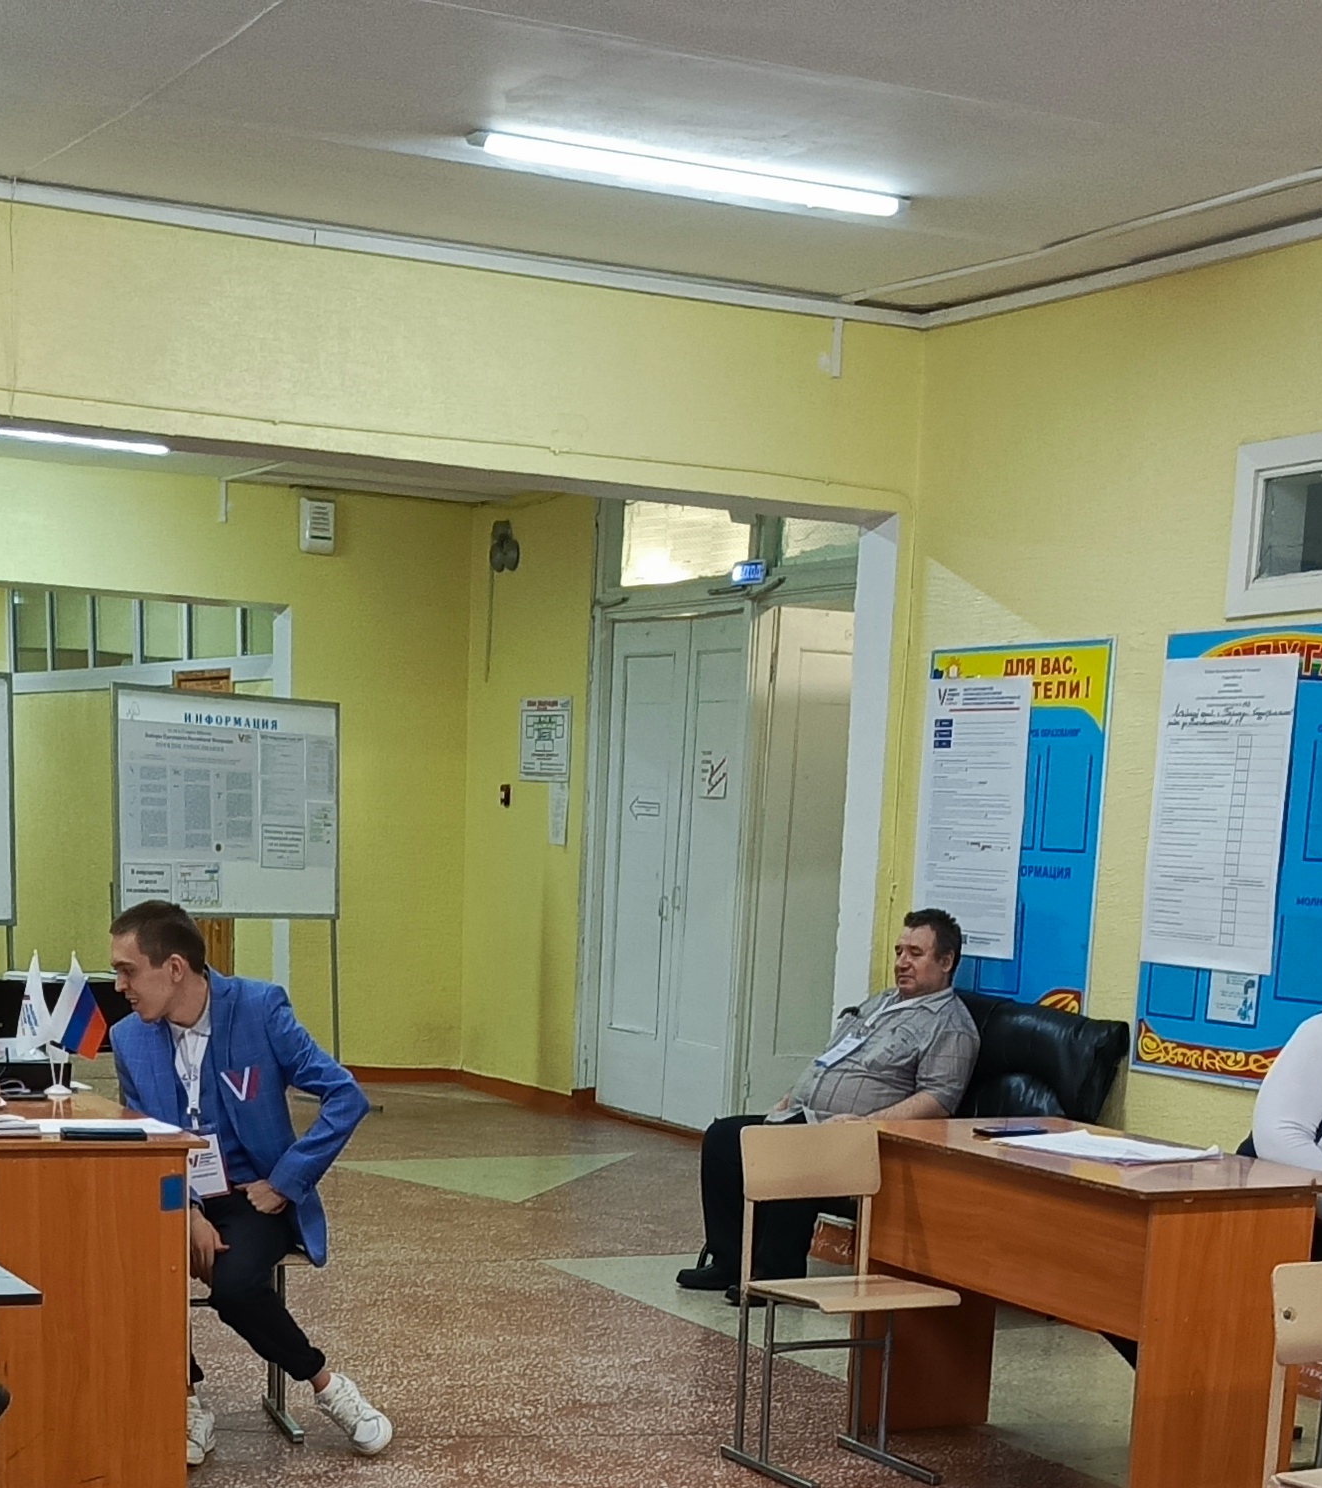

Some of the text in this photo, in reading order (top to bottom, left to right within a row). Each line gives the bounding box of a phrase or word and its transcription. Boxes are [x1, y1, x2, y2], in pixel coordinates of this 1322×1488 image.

[1003, 656, 1078, 676] ДЛЯ ВАС,
[184, 712, 278, 730] ИНФОРМАЦИЯ
